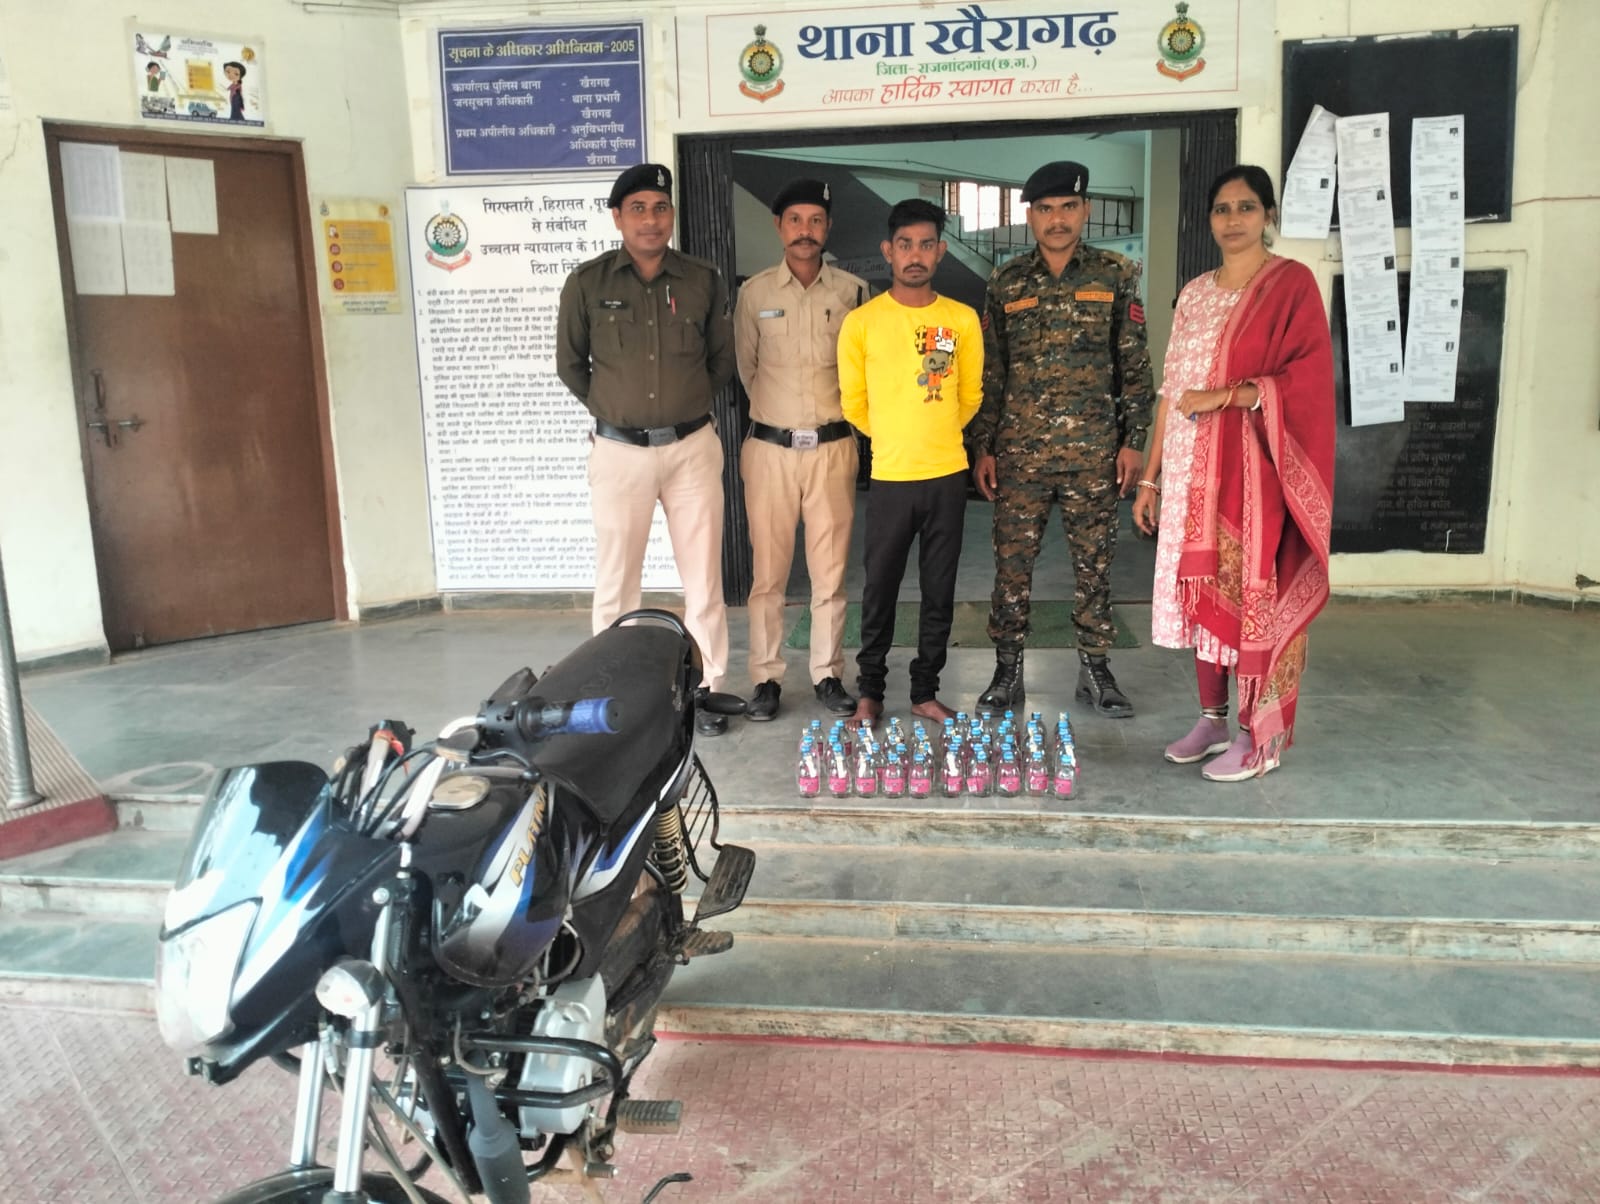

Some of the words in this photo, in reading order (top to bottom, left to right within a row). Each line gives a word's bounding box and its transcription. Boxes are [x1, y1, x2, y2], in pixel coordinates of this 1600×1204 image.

[797, 22, 915, 61] थाना
[924, 4, 1118, 57] खैरागढ़
[448, 45, 480, 64] सूचना
[482, 42, 494, 57] के
[495, 40, 543, 58] अधिकार
[491, 78, 518, 94] पुलिस
[520, 80, 541, 91] थाना
[822, 88, 875, 105] आपका
[880, 75, 943, 105] हार्दिक
[948, 77, 1015, 100] स्वागत
[1020, 78, 1061, 95] करता
[453, 97, 493, 110] जनसूचना
[495, 93, 533, 106] अधिकारी
[572, 94, 592, 104] थाना
[595, 90, 621, 103] प्रभारी
[455, 127, 476, 138] प्रथम
[480, 124, 515, 137] अपीलीय
[518, 123, 556, 136] अधिकारी
[571, 121, 625, 138] अनुविभागीय
[569, 137, 607, 151] अधिकारी
[610, 136, 636, 152] पुलिस
[483, 196, 534, 214] गिरफ्तारी
[532, 218, 541, 233] से
[546, 216, 587, 232] संबंधित
[480, 243, 521, 256] उच्चतम
[523, 241, 574, 254] न्यायालय
[576, 237, 588, 253] के
[592, 239, 605, 251] 11
[530, 259, 558, 275] दिशा
